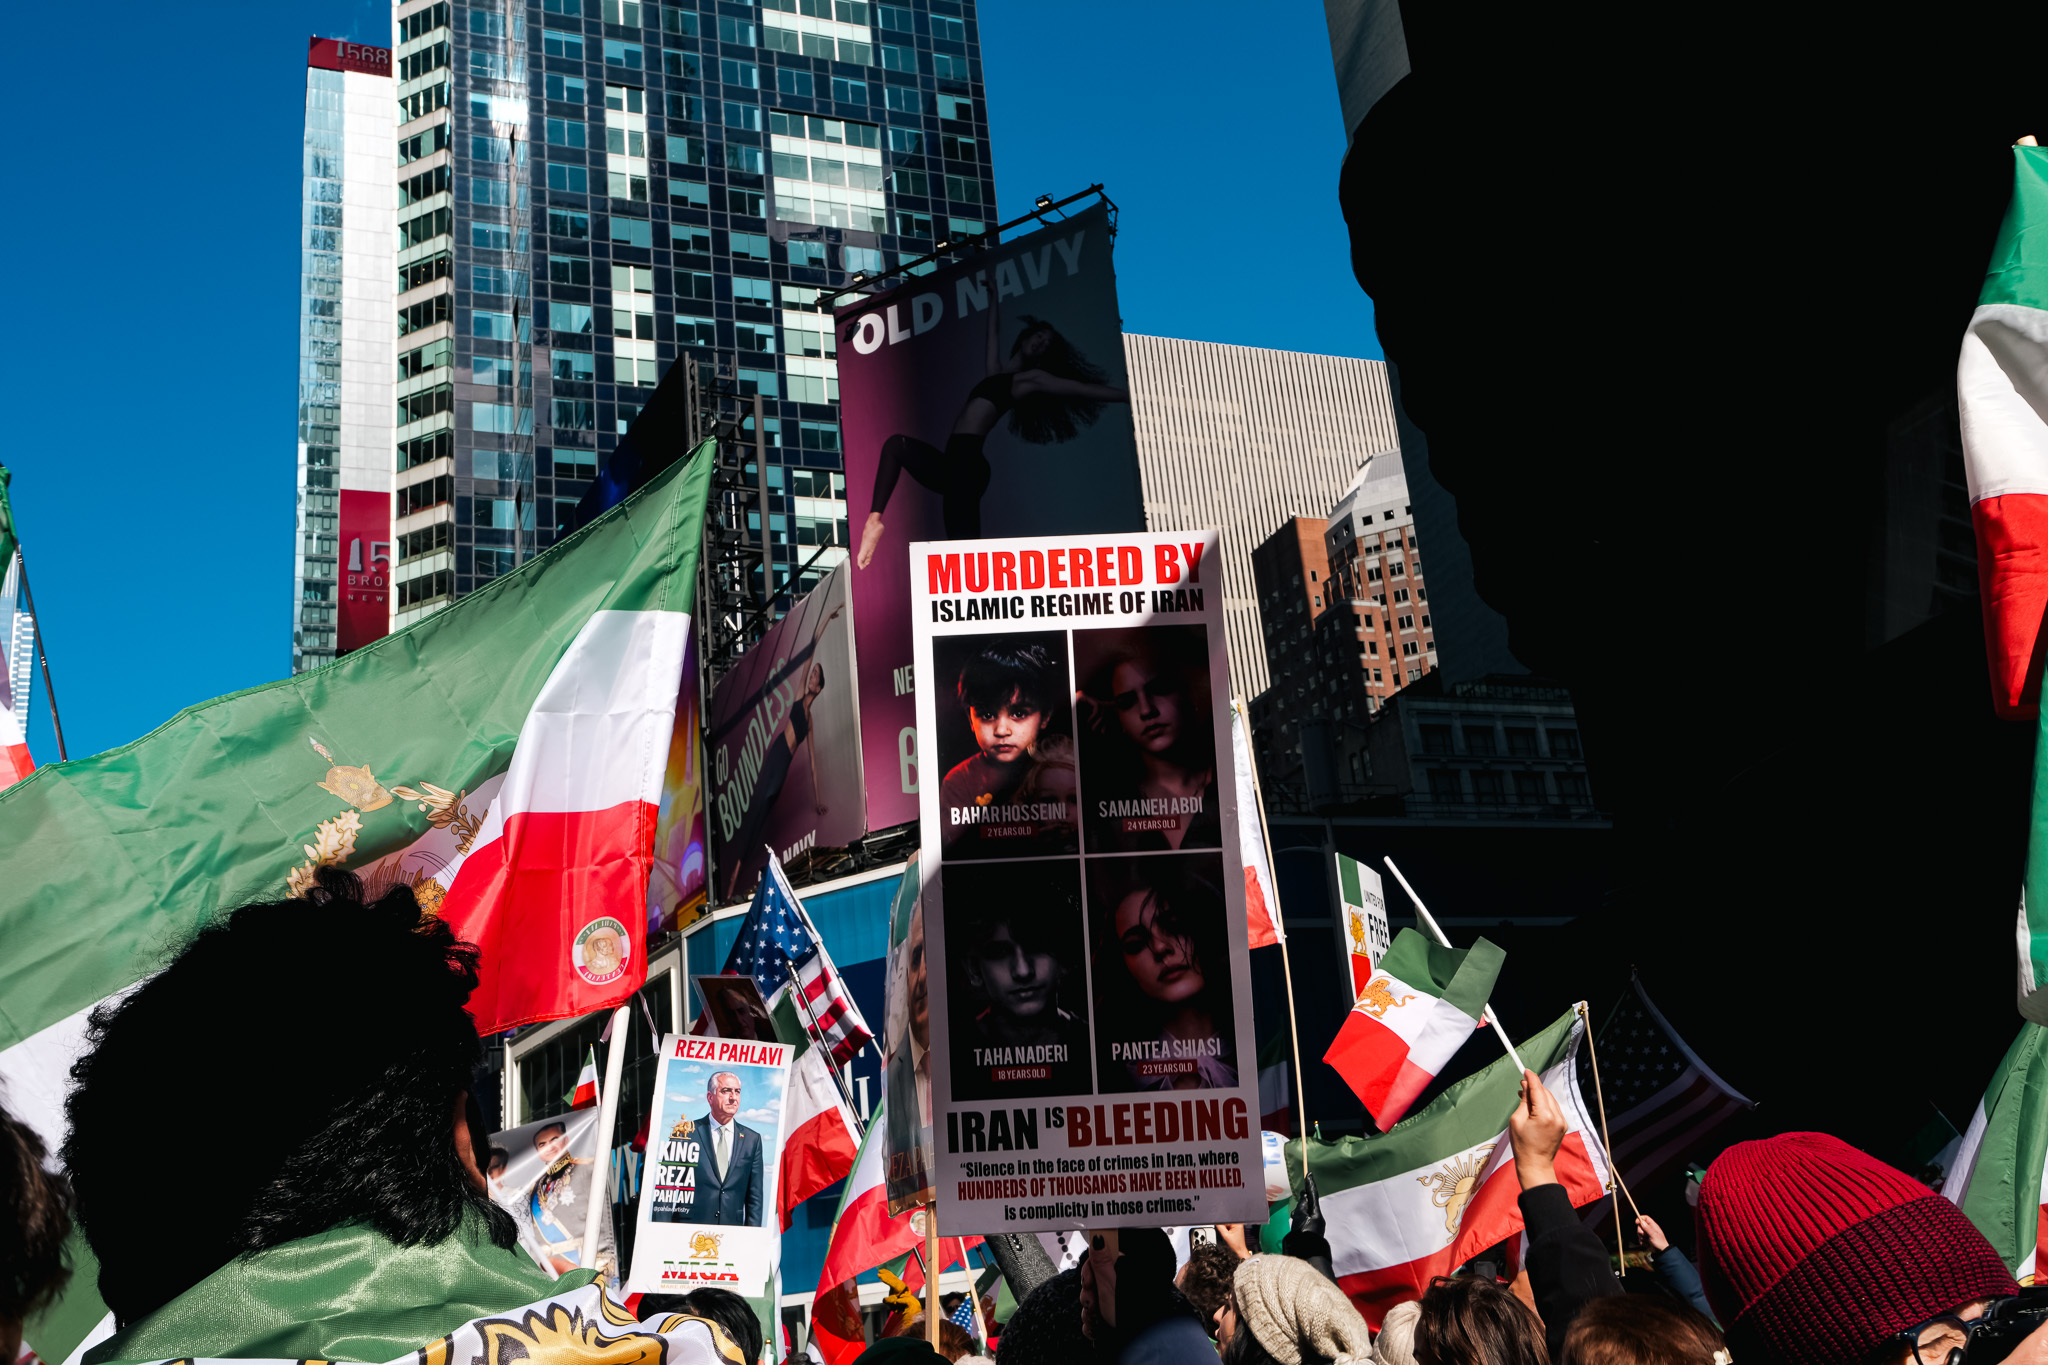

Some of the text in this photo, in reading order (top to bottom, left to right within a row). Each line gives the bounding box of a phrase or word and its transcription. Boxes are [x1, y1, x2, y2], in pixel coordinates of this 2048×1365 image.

[336, 41, 389, 65] 1568
[852, 230, 1086, 355] OLD NAVY
[928, 542, 1204, 595] MURDERED BY
[348, 575, 390, 587] BRO
[348, 594, 383, 602] NEW
[932, 588, 1204, 623] ISLAMIC REGIME OF IRAN
[893, 664, 914, 697] NE
[718, 657, 794, 843] BOUNDLESS
[716, 743, 729, 786] GO
[950, 802, 1066, 825] BAHAR HOSSEINI
[1099, 796, 1203, 818] SAMANEH ABDI
[988, 826, 1031, 837] 2 YEARS OLD
[1128, 819, 1176, 831] 24 YEARS OLD
[1368, 912, 1391, 950] FREE
[675, 1039, 783, 1066] REZA PAHLAVI
[973, 1044, 1068, 1066] TAHA NADERI
[1112, 1037, 1221, 1061] PANTEA SHIASI
[998, 1068, 1046, 1080] 18 YEARS OLD
[1143, 1062, 1193, 1075] 23 YEARS OLD
[947, 1097, 1249, 1153] IRAN IS BLEEDING
[658, 1140, 700, 1163] KING
[960, 1150, 1239, 1177] “Silence in the face of crimes in Iran, where
[655, 1166, 695, 1187] REZA
[958, 1168, 1245, 1200] HUNDREDS OF THOUSANDS HAVE BEEN KILLED,
[653, 1189, 695, 1204] PAHLAVI
[653, 1205, 690, 1214] @pahlavartistry
[1004, 1205, 1016, 1220] is
[1019, 1201, 1089, 1220] complicity
[1091, 1201, 1104, 1216] in
[1107, 1199, 1143, 1215] those
[662, 1260, 739, 1281] MIGA
